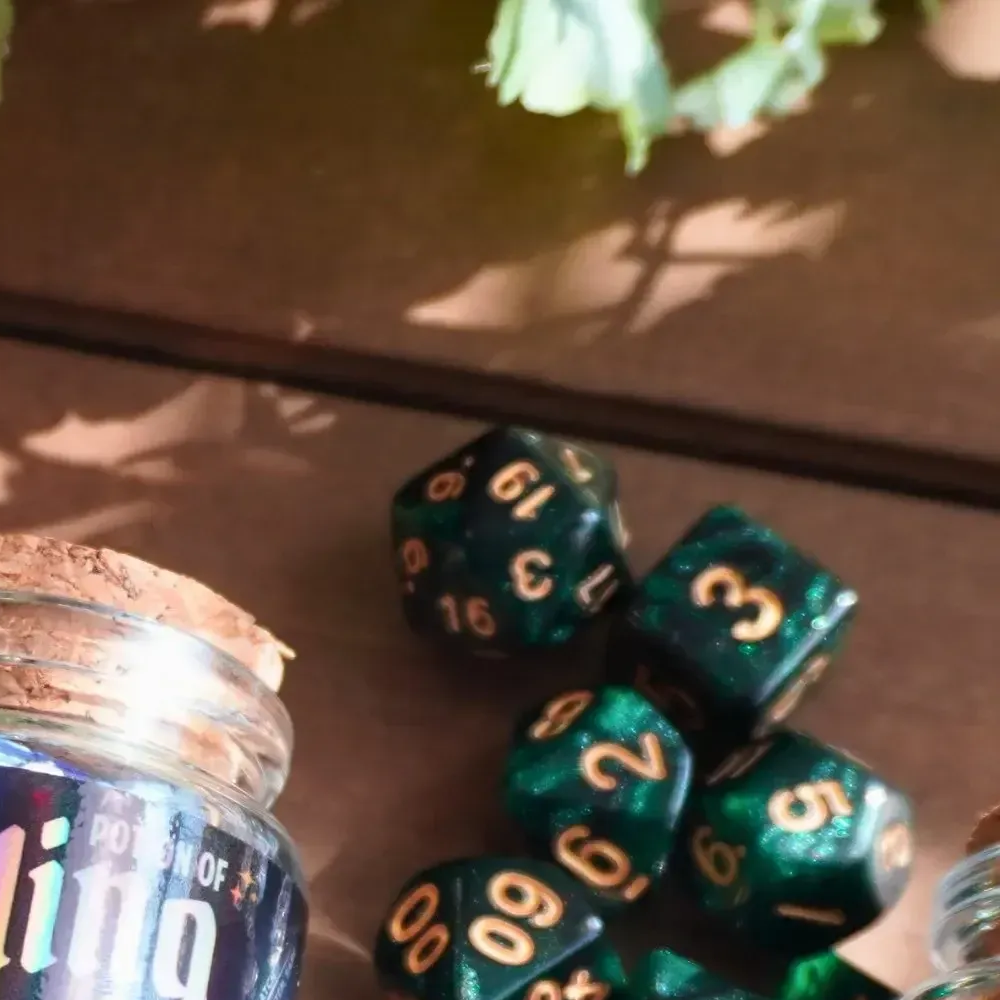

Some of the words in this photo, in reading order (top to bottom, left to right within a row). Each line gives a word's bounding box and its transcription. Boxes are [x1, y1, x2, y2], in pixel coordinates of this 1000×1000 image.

[510, 550, 553, 600] 3
[691, 565, 785, 642] 3
[580, 731, 668, 790] 2
[766, 780, 854, 833] 5
[197, 850, 229, 893] OF
